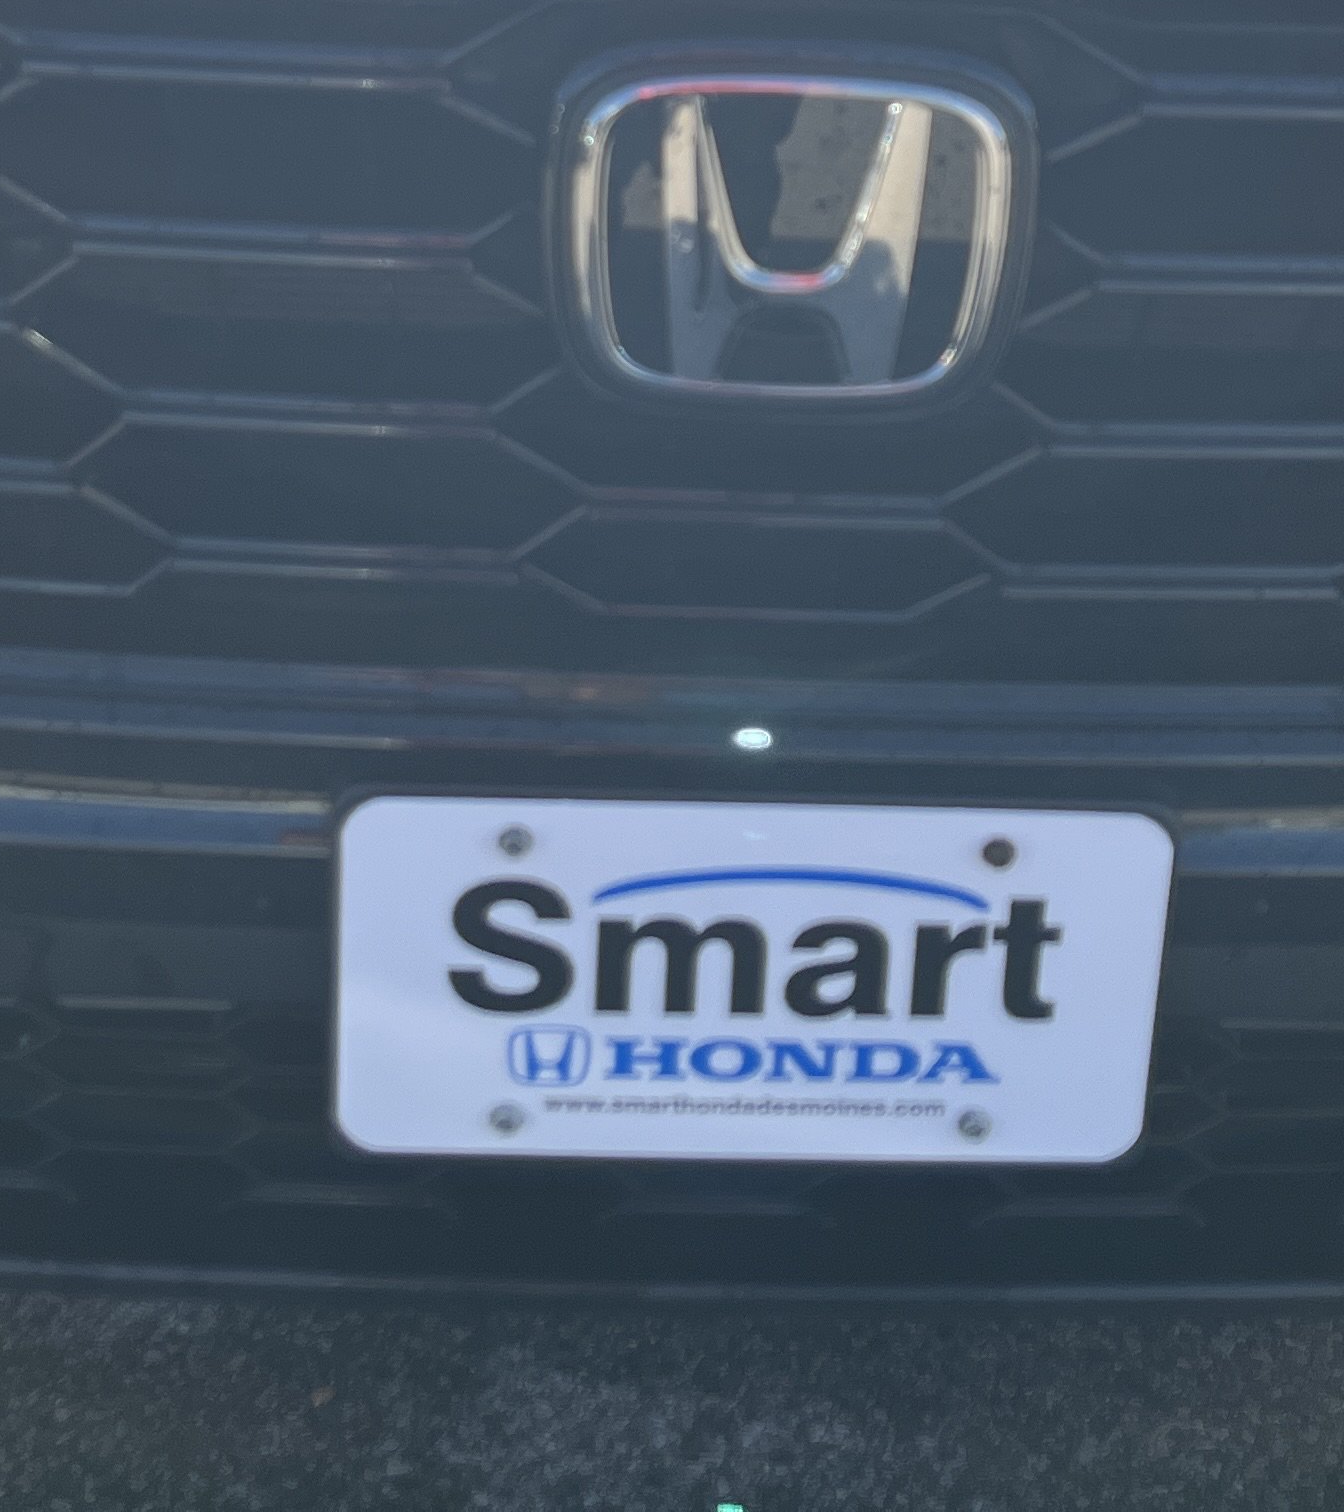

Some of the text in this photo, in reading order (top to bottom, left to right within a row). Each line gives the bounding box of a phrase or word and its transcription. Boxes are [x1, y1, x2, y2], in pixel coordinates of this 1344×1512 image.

[447, 878, 1062, 1020] Smart
[604, 1036, 1000, 1085] HONDA
[543, 1093, 947, 1118] www.smarthondadesmoines.com
